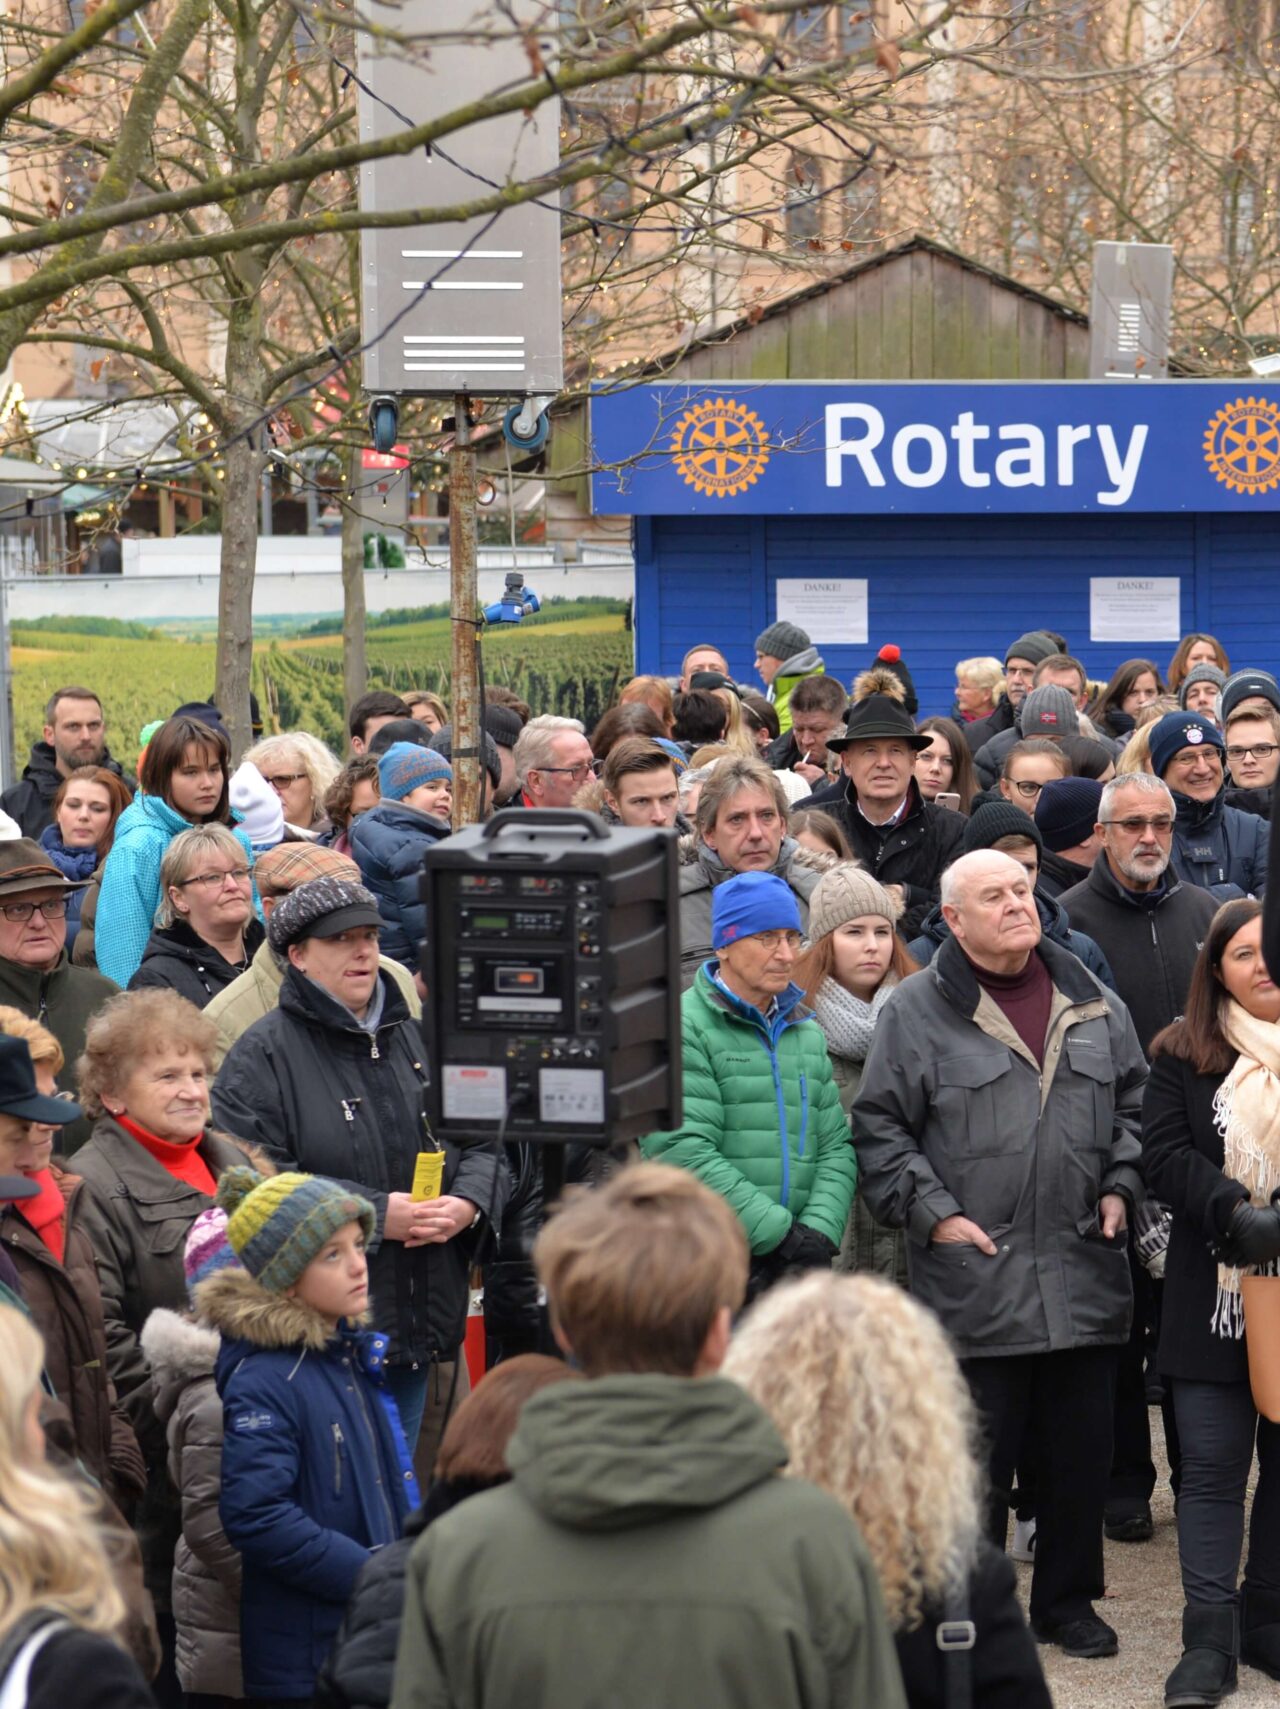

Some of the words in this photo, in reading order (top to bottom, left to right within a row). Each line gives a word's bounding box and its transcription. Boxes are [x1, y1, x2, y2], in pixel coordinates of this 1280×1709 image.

[825, 402, 1149, 506] Rotary
[804, 583, 842, 593] DANKE!
[1116, 581, 1154, 591] DANKE!
